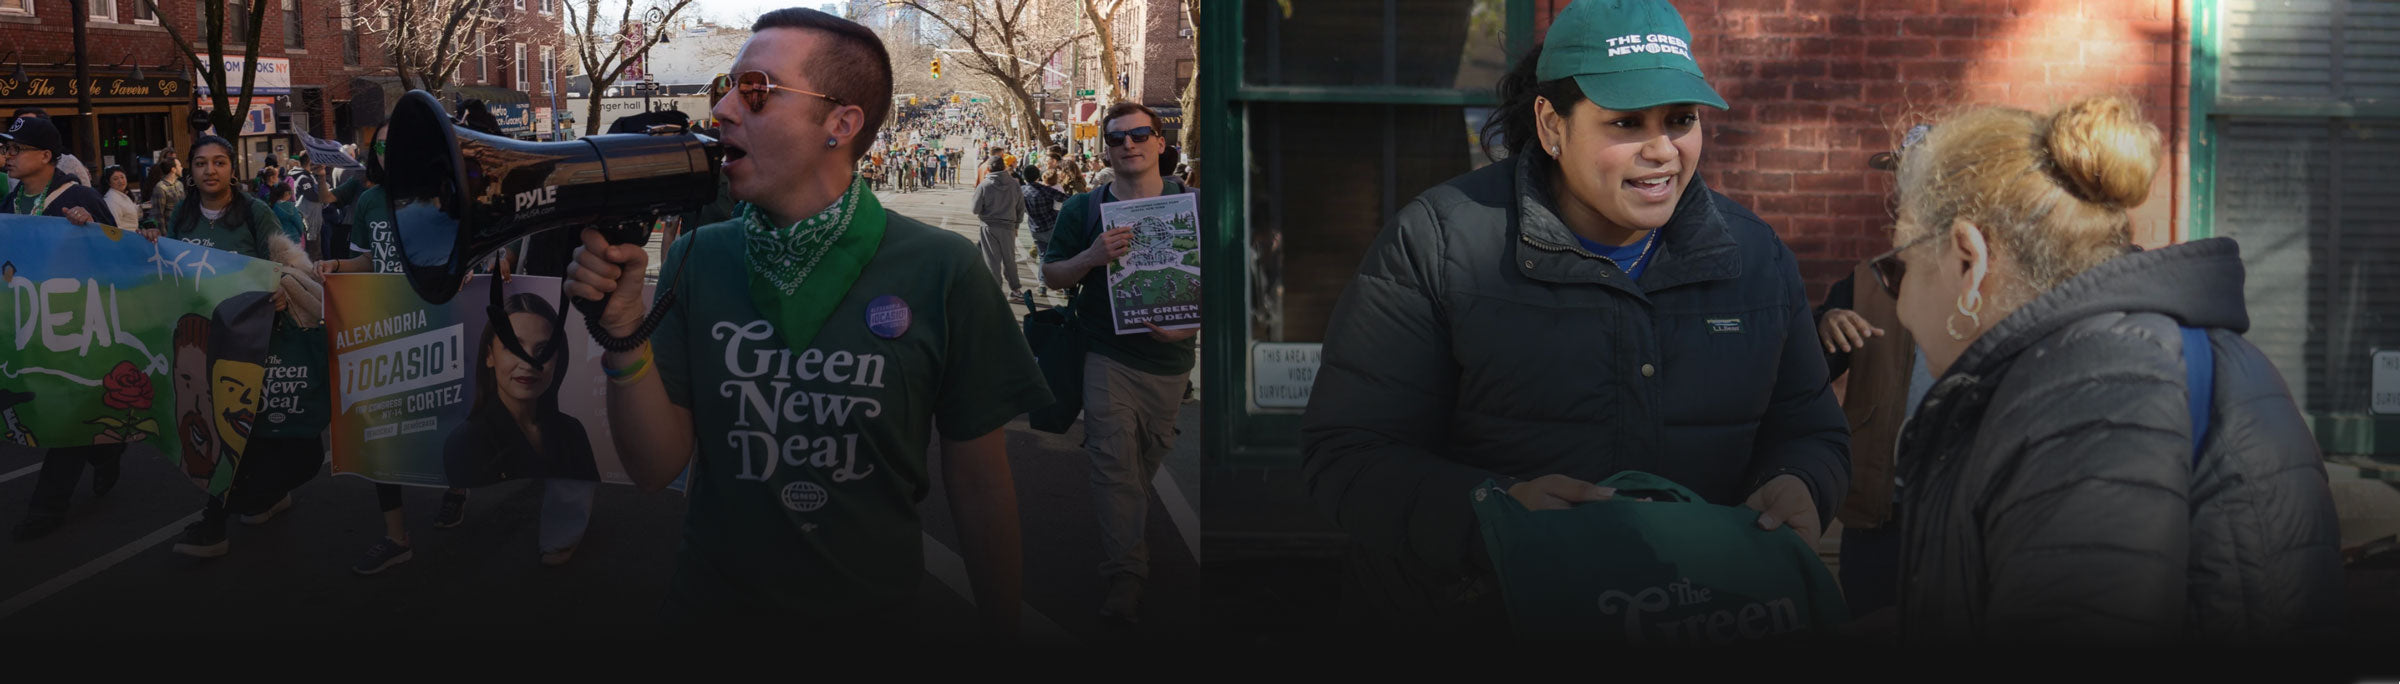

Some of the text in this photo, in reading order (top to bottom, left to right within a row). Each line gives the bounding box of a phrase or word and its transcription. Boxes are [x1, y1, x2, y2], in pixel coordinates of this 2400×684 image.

[1606, 34, 1688, 50] THE GREEN
[1608, 44, 1691, 61] NEW DEAL
[275, 64, 288, 73] NY
[27, 78, 55, 96] The
[110, 79, 149, 95] Tavern
[600, 101, 640, 112] nger hall
[515, 185, 559, 213] PYLE
[371, 242, 396, 261] Ne
[372, 259, 404, 274] Dea
[8, 276, 150, 357] DEAL
[1122, 304, 1199, 317] THE GREEN
[1124, 312, 1201, 325] NEW DEAL
[336, 309, 427, 349] ALEXANDRIA
[268, 355, 282, 365] The
[711, 319, 885, 388] Green
[1263, 349, 1280, 362] THIS
[1285, 349, 1306, 362] AREA
[263, 366, 308, 379] reen
[1288, 367, 1312, 381] VIDEO
[407, 384, 462, 413] CORTEZ
[1260, 385, 1309, 400] SURVEILLAN
[720, 380, 881, 435] New
[1668, 577, 1713, 607] The
